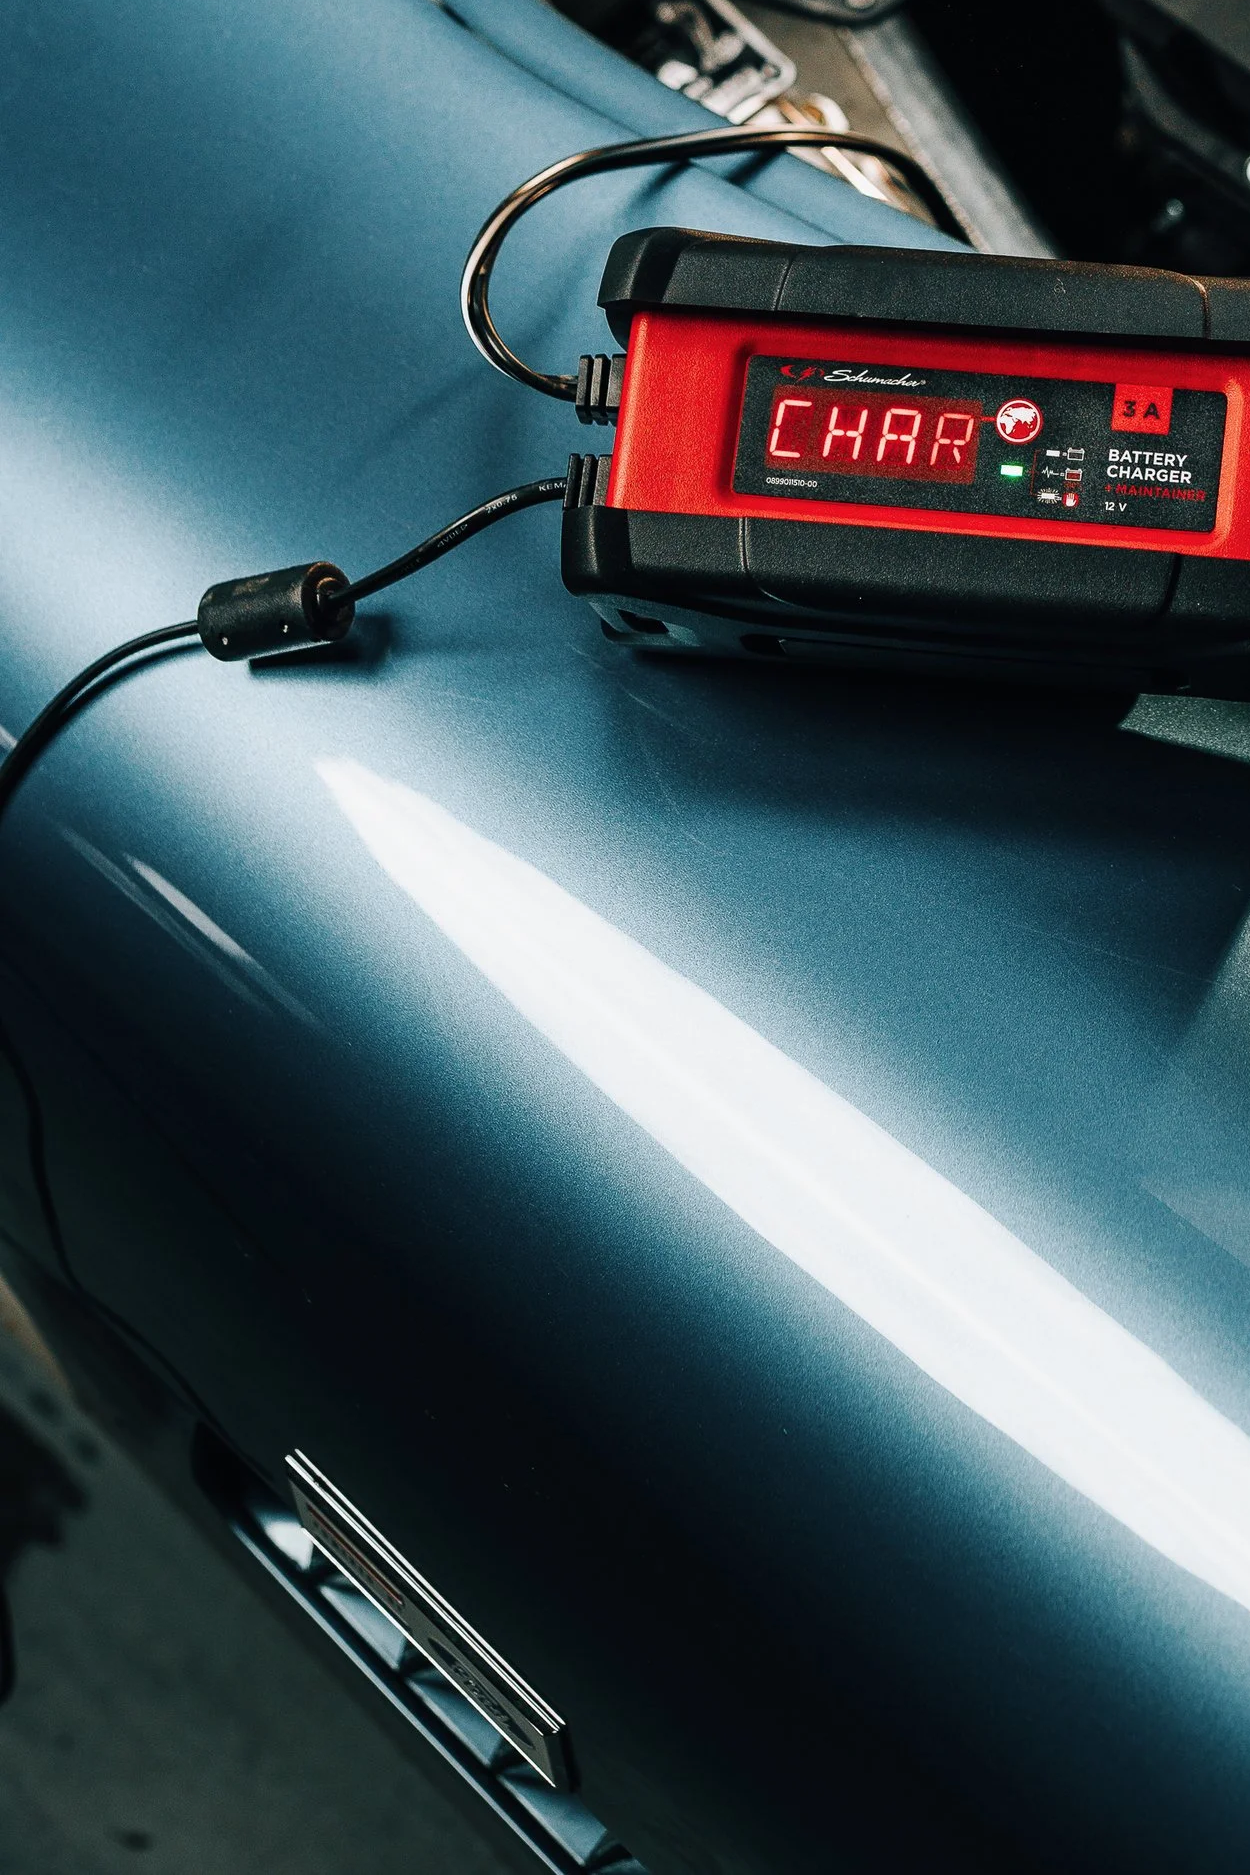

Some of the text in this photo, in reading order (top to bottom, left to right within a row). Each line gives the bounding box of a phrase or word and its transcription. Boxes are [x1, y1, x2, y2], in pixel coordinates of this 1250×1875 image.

[1123, 400, 1160, 419] 3 A
[769, 398, 974, 466] CHAR
[1108, 448, 1188, 468] BATTERY
[1106, 465, 1192, 484] CHARGER
[1115, 483, 1207, 502] MAINTAINER
[1104, 501, 1127, 512] 12 V
